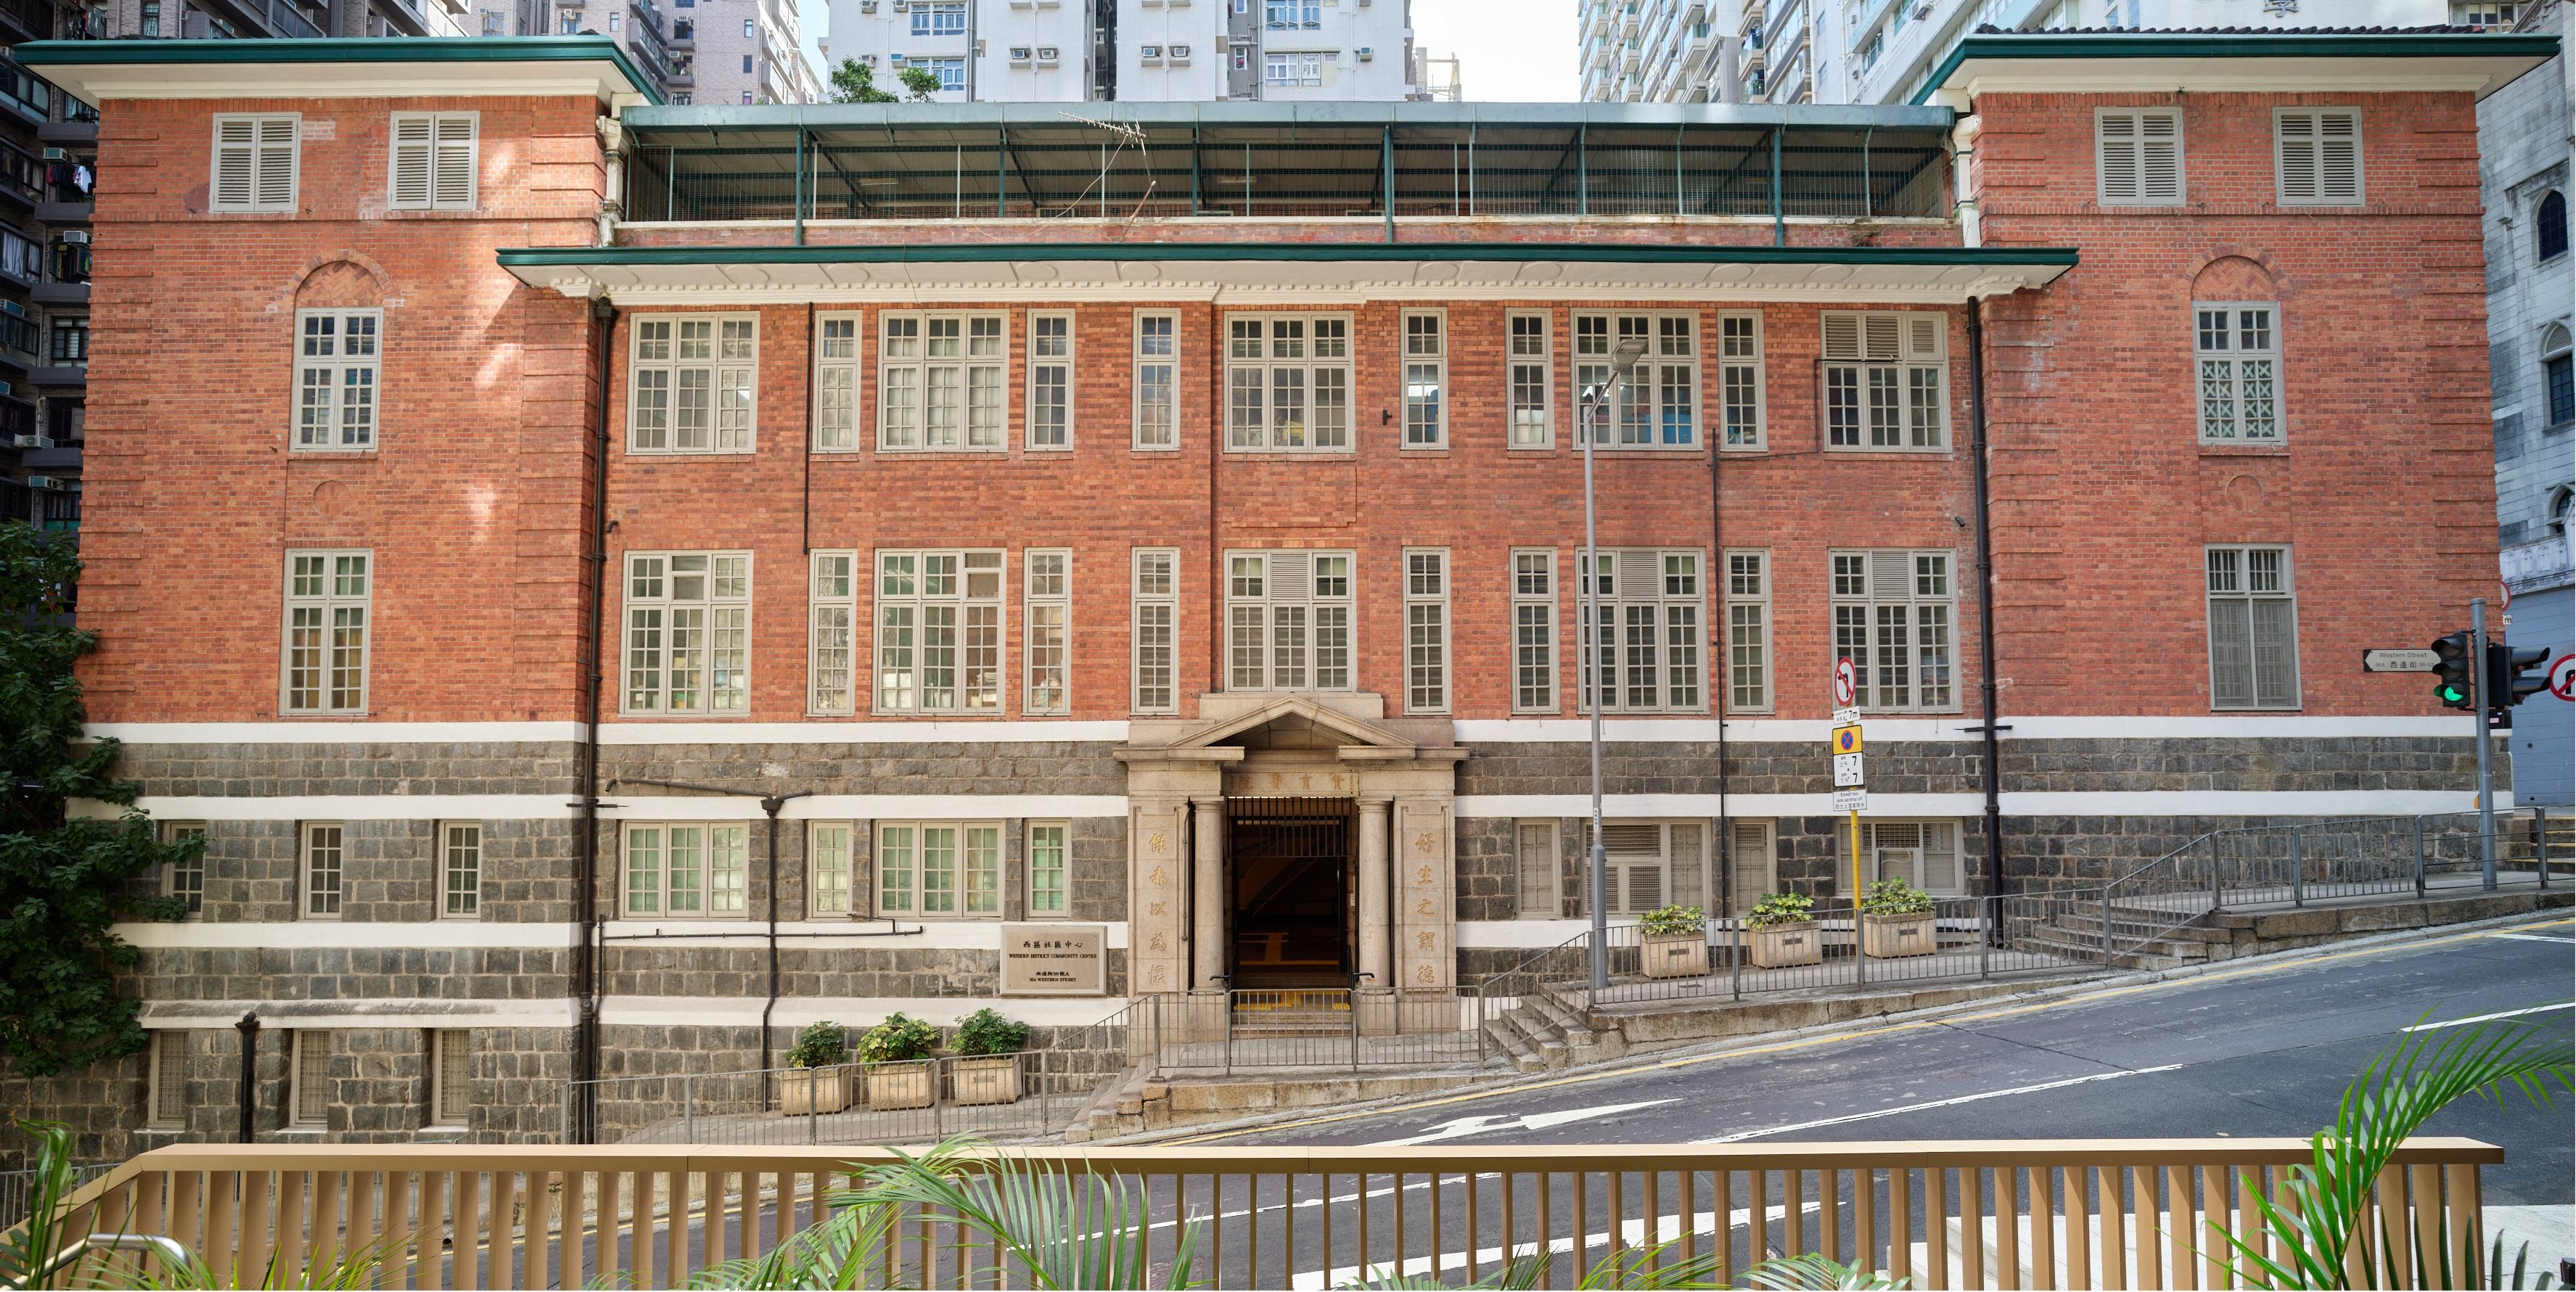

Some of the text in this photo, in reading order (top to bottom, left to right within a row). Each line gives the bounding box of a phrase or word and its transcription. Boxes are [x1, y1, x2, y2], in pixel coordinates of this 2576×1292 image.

[1852, 755, 1857, 766] 7
[1853, 773, 1858, 783] 7
[1023, 940, 1083, 949] 西區社區中心
